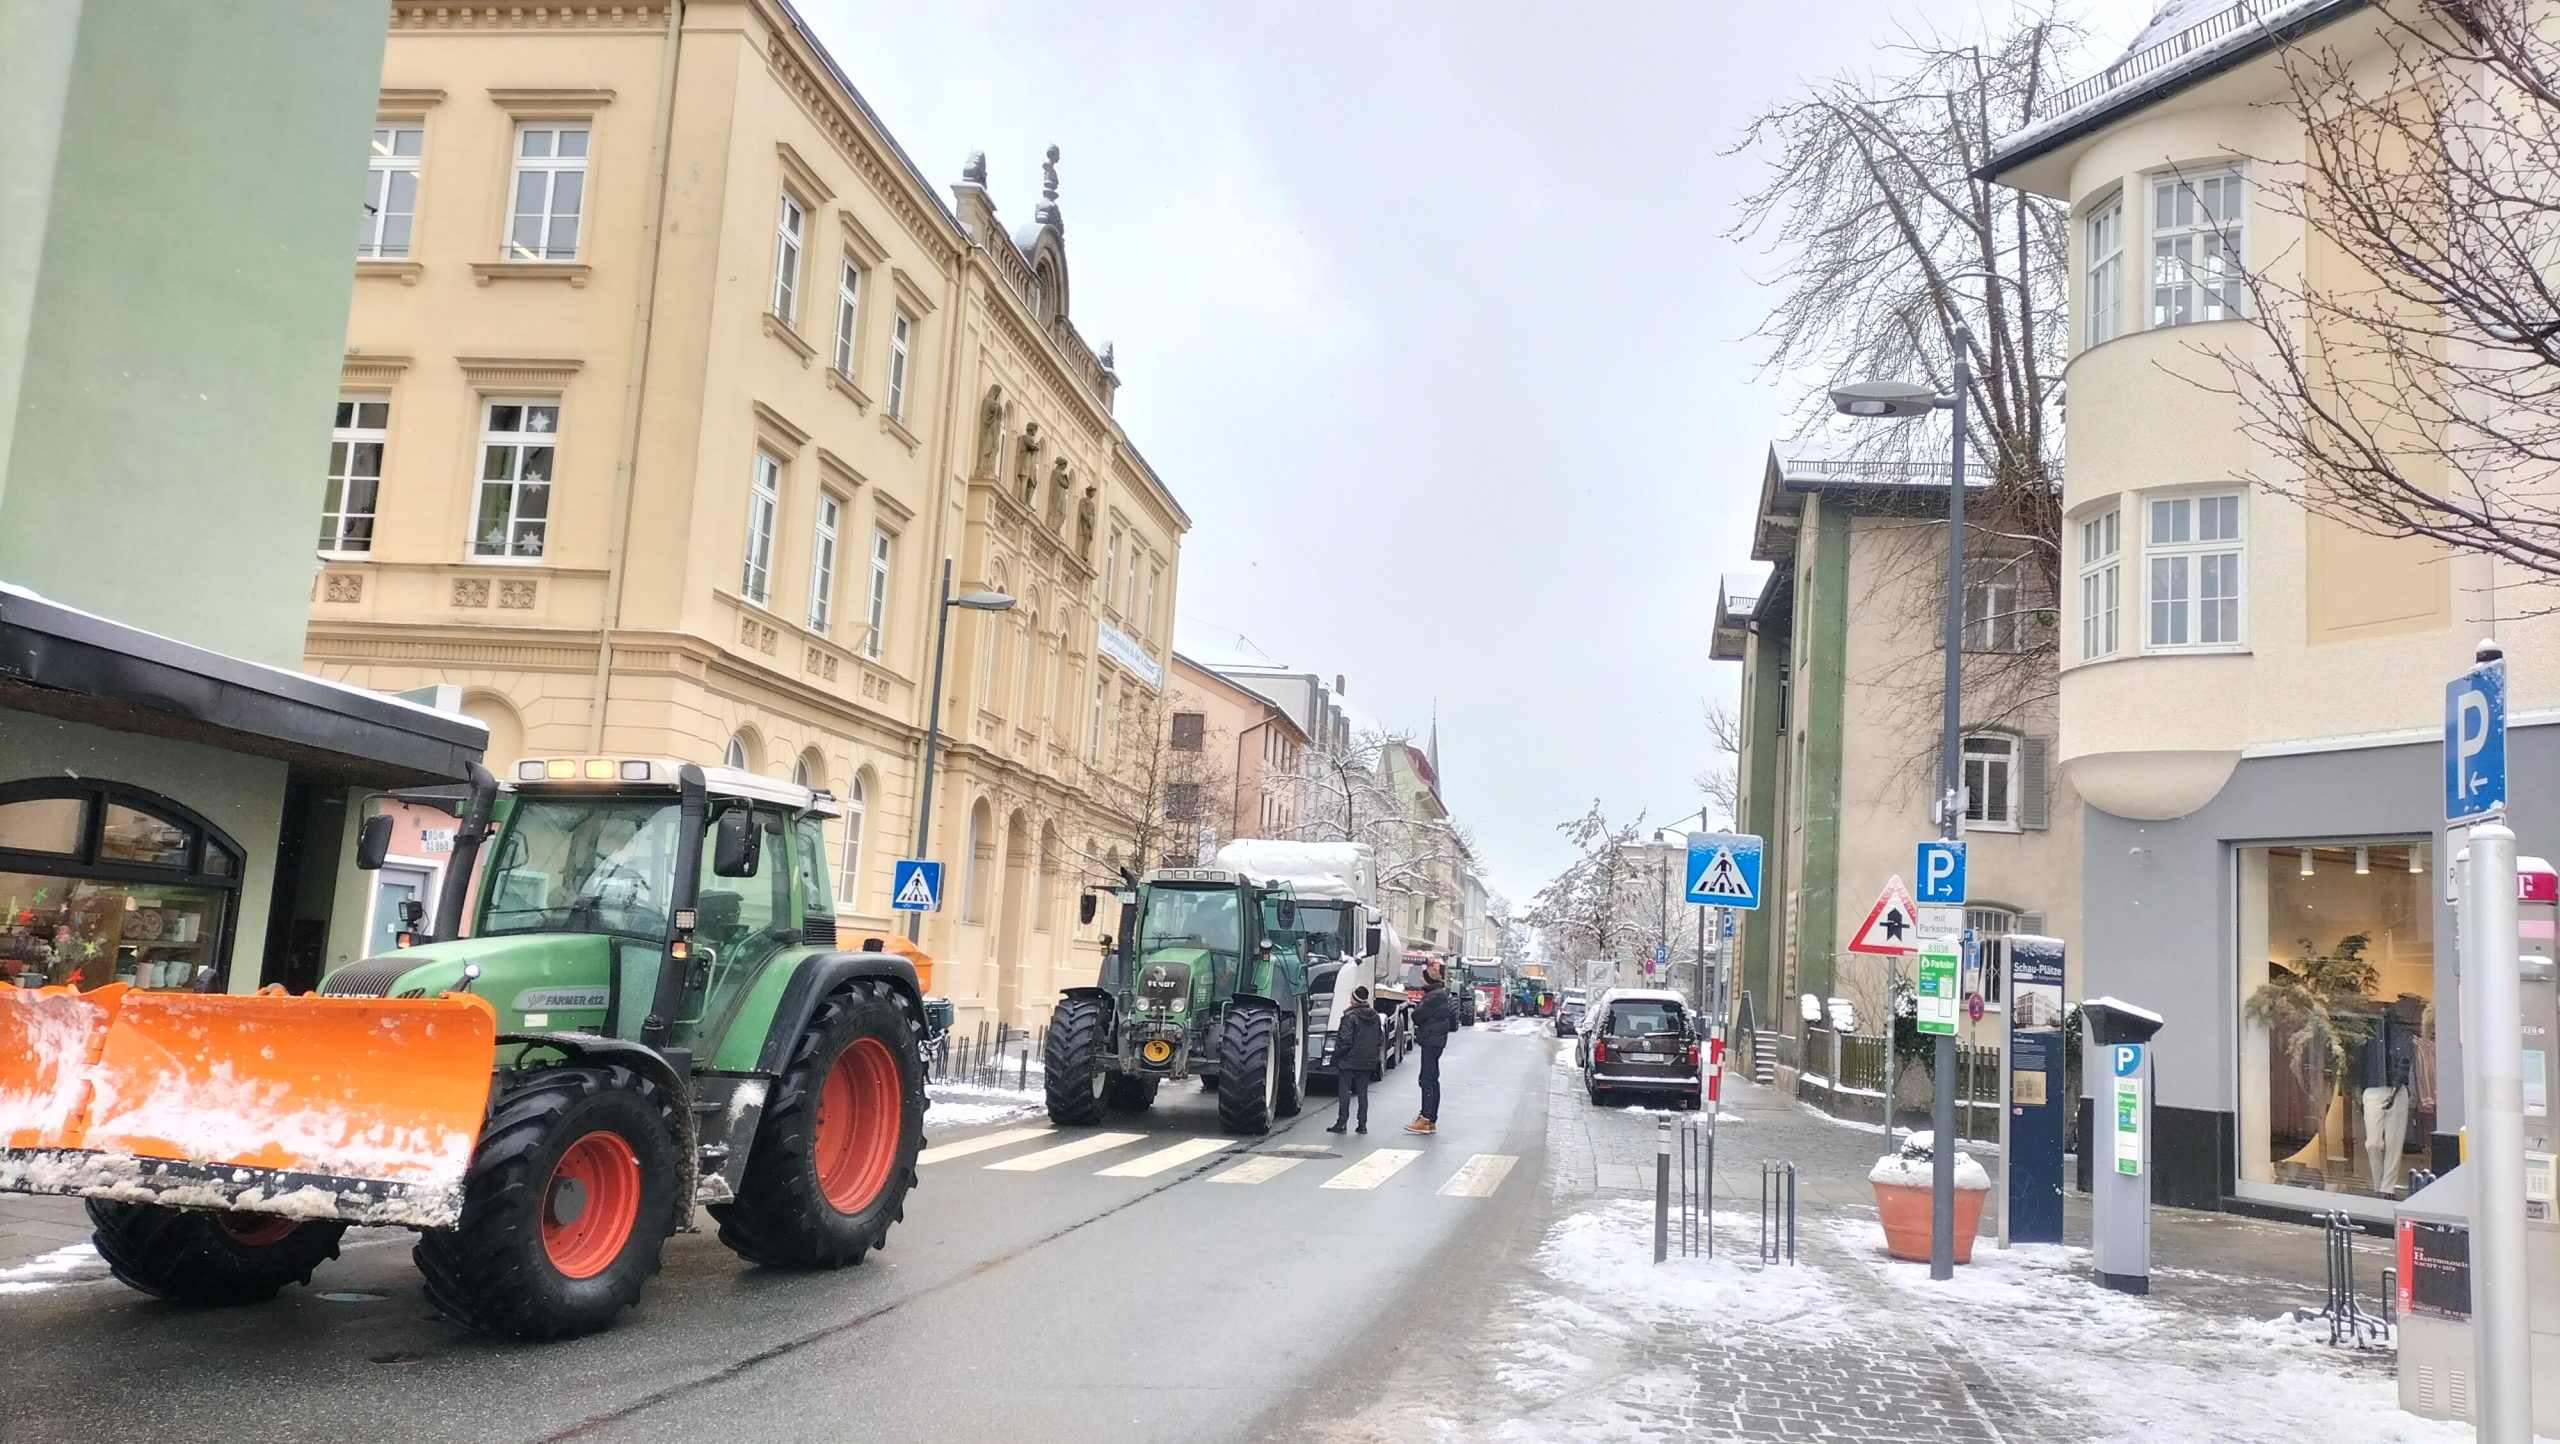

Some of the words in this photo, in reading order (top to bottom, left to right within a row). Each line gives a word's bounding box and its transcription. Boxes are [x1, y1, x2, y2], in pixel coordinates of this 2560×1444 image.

[2457, 689, 2489, 800] P
[1927, 849, 1955, 896] P
[1934, 914, 1946, 923] mit
[1919, 923, 1960, 935] Parkschein
[1928, 944, 1949, 954] 83038
[1657, 949, 1664, 962] P
[1931, 959, 1955, 969] Parkster
[2014, 961, 2062, 976] Schau-Plätze
[1147, 980, 1176, 988] FENDT
[546, 995, 587, 1006] FARMER
[587, 995, 605, 1006] 412
[2117, 1047, 2135, 1072] P
